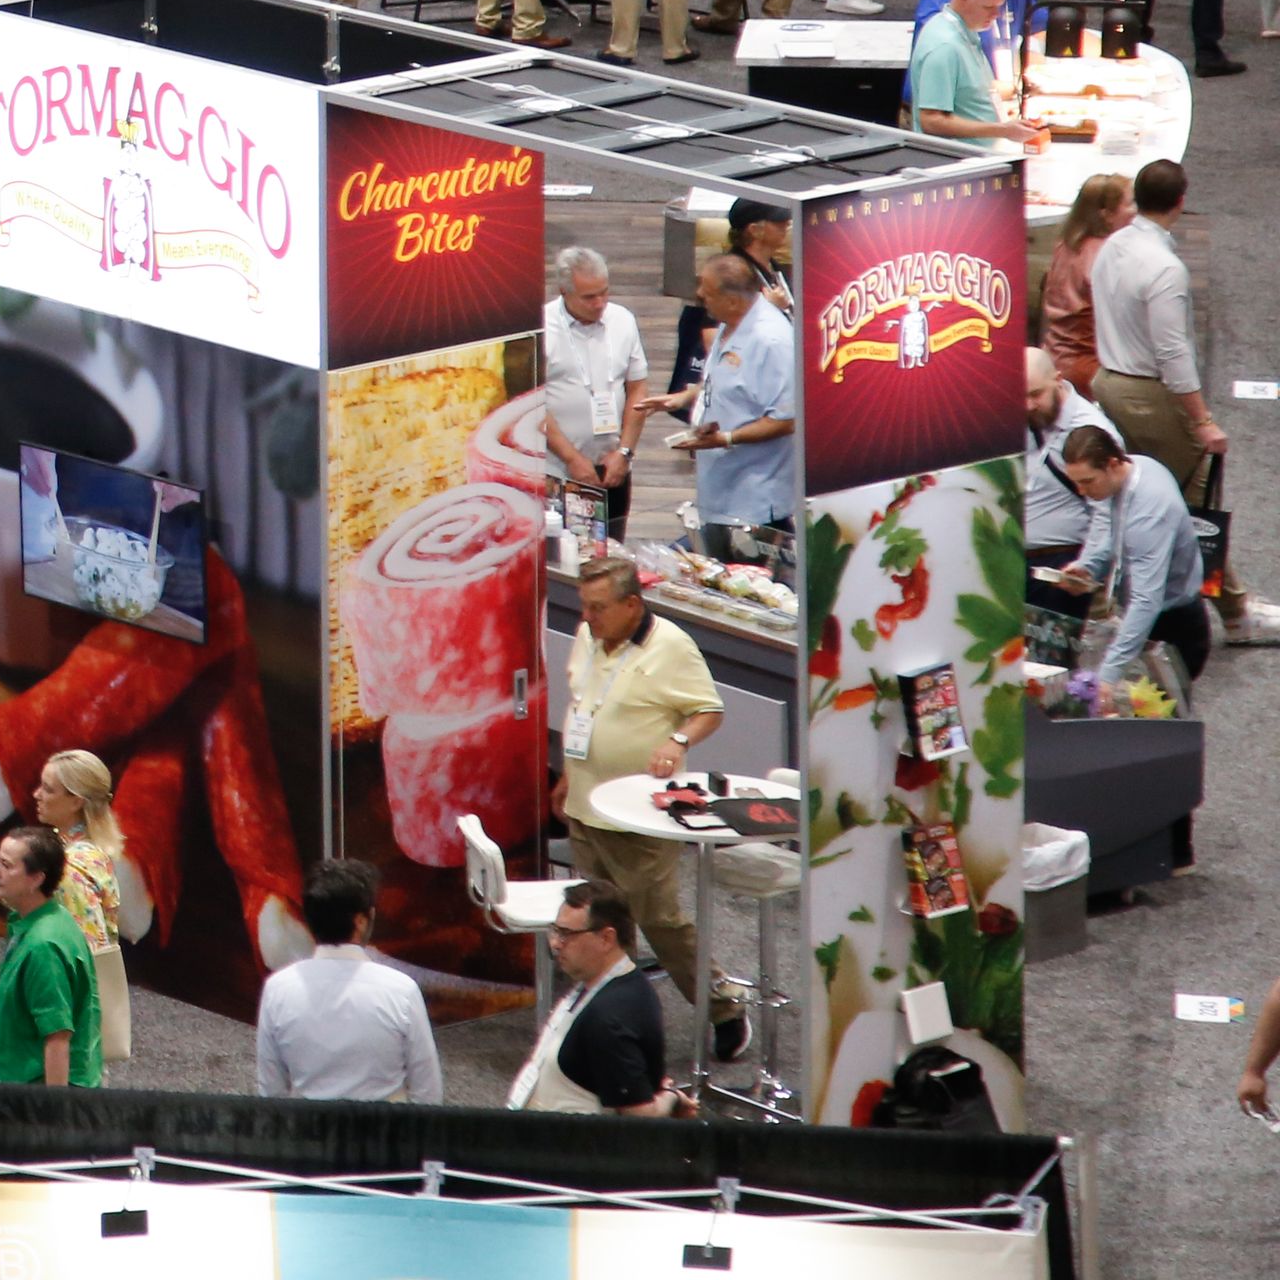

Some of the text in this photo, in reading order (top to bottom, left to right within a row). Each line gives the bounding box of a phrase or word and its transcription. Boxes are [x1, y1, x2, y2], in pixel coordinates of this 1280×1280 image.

[338, 146, 533, 222] Charcuterie
[811, 174, 1021, 226] AWARD-WINNING
[393, 214, 479, 263] Bites
[818, 250, 1012, 371] FORMAGGIO
